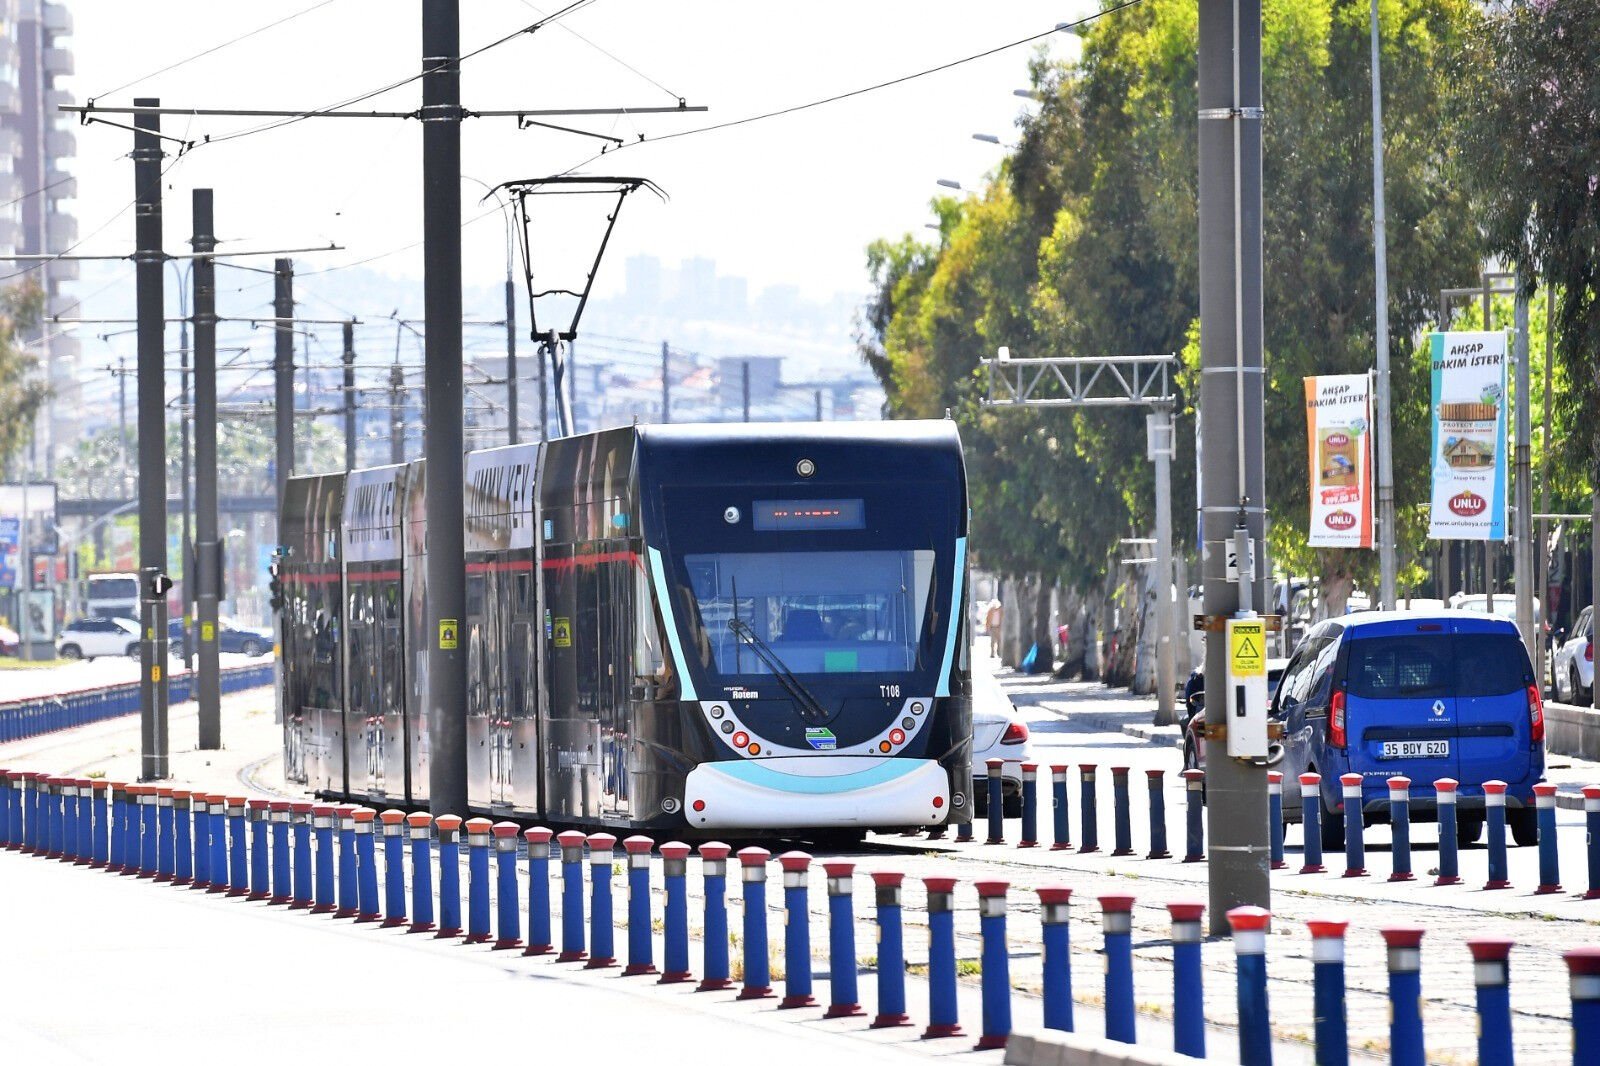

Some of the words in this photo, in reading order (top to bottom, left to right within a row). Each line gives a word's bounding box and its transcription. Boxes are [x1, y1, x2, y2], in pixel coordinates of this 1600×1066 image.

[1450, 342, 1484, 357] AHŞAP
[1433, 358, 1467, 371] BAKIM
[1453, 498, 1481, 509] UNLU
[1328, 515, 1352, 525] UNLU
[732, 690, 759, 699] Rotem
[880, 685, 900, 698] T108
[1385, 743, 1398, 755] 35
[1427, 742, 1447, 754] 620
